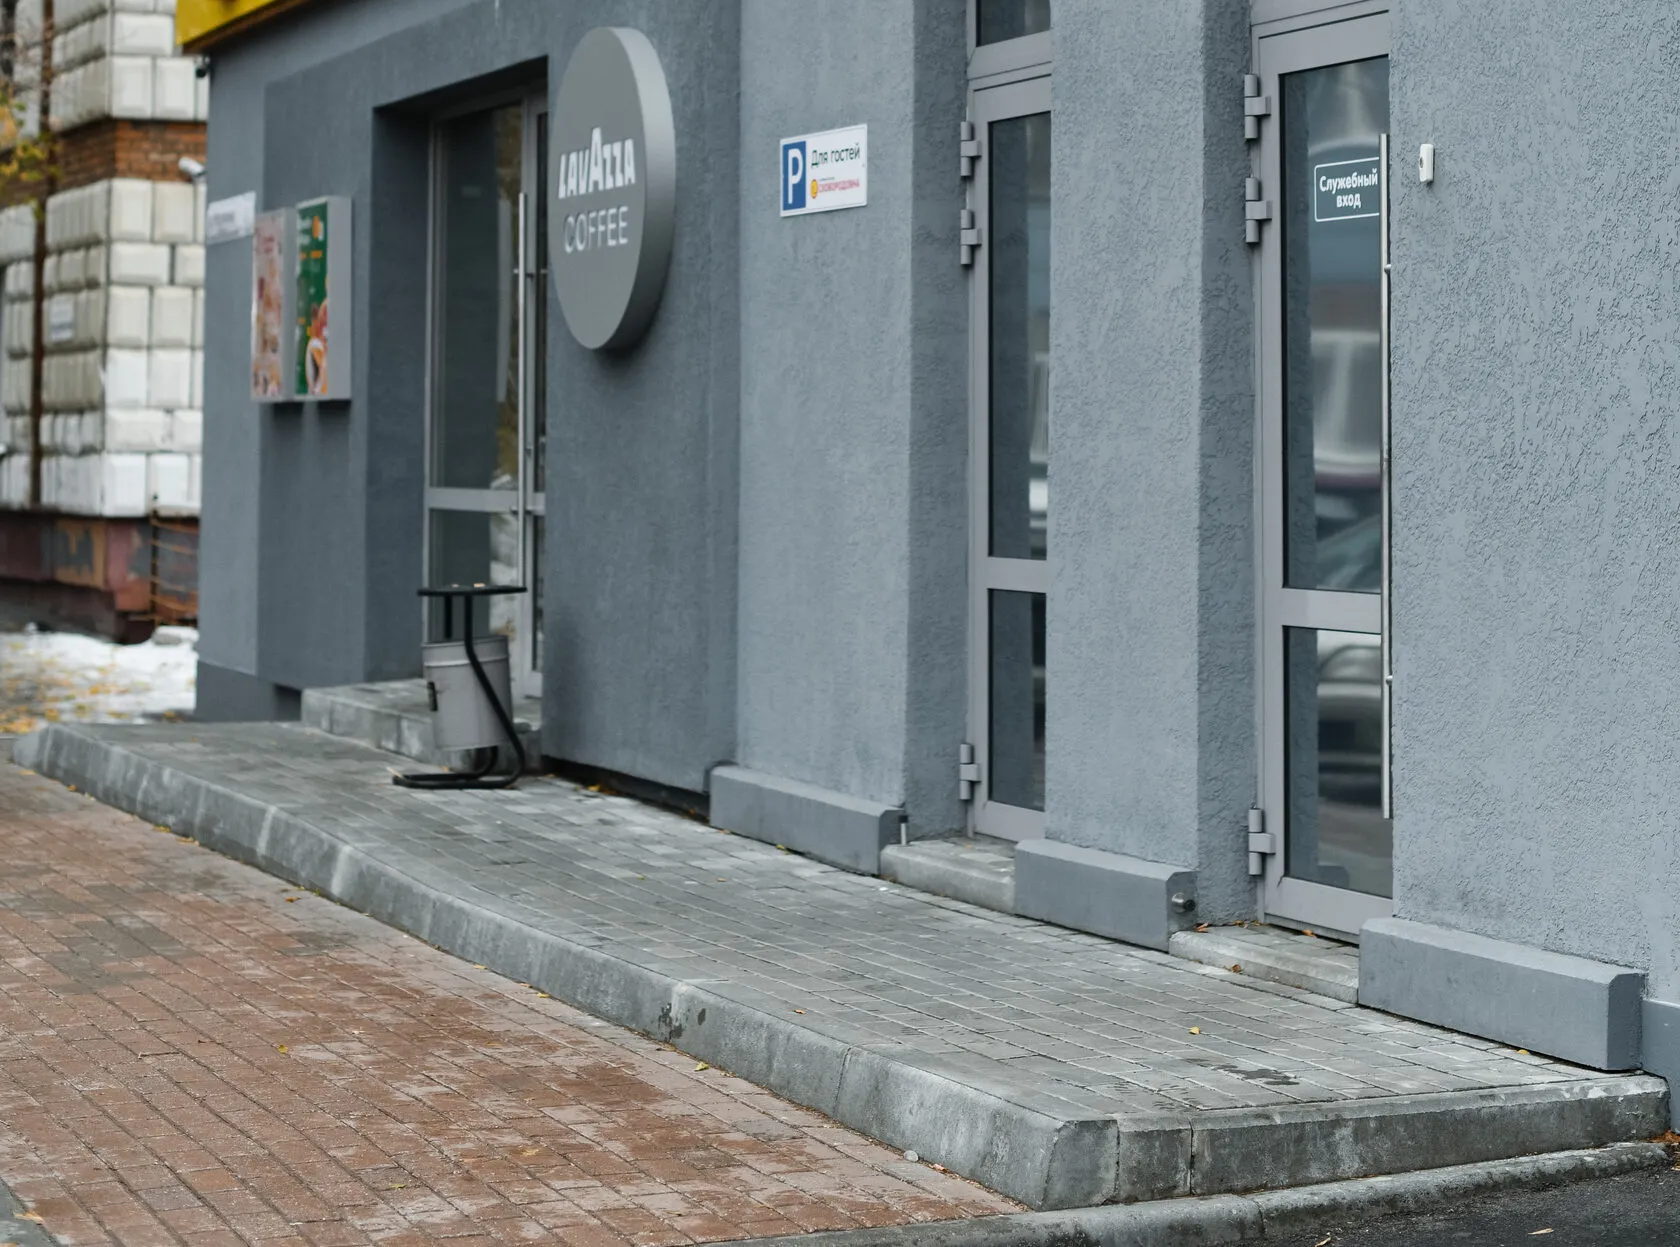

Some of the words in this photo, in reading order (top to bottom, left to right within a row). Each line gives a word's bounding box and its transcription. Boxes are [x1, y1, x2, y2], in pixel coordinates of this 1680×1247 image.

[558, 127, 636, 199] LAVAZZA
[811, 149, 828, 168] Для
[830, 142, 860, 163] гостей
[787, 148, 804, 204] P
[1320, 168, 1378, 194] Служебный
[1336, 193, 1361, 209] вход
[564, 206, 628, 253] COFFEE
